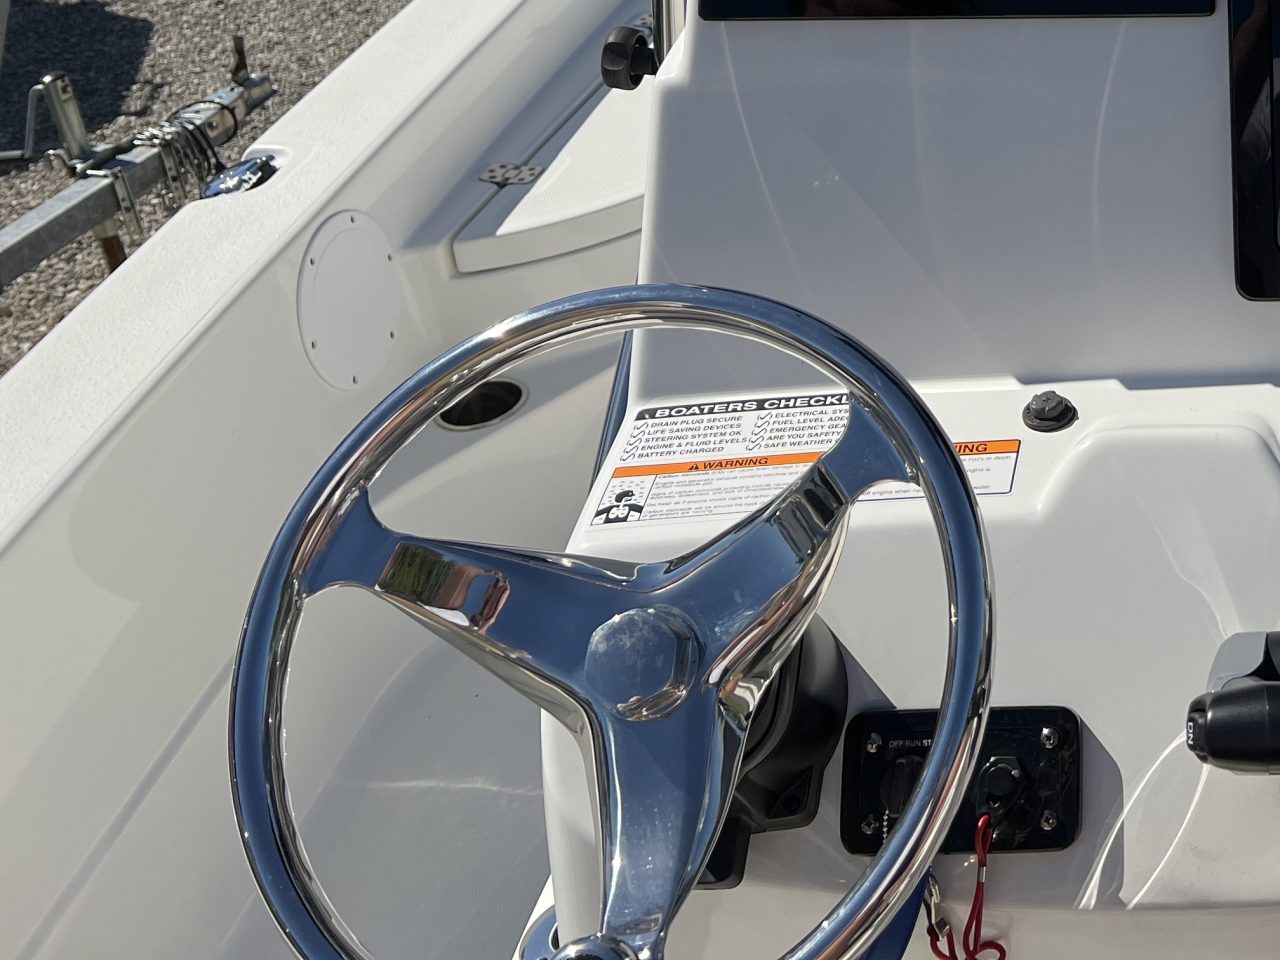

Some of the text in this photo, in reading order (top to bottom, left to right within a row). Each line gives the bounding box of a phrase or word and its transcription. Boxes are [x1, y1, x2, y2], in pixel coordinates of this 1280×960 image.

[655, 400, 760, 418] BOATERS
[774, 410, 828, 419] ELECTRICAL
[650, 415, 743, 428] DRAIN PLUG SECURE
[771, 418, 795, 426] FUEL
[797, 416, 825, 424] LEVEL
[647, 423, 741, 436] LIFE SAVING DEVICES
[769, 425, 826, 434] EMERGENCY
[807, 430, 841, 438] SAFETY
[644, 435, 685, 443] STEERING
[687, 431, 727, 440] SYSTEM
[640, 443, 674, 451] ENGINE
[685, 439, 714, 447] FLUID
[715, 437, 748, 445] LEVELS
[763, 438, 832, 449] SAFE WEATHER
[637, 446, 724, 459] BATTERY CHARGED
[703, 457, 768, 470] WARNING
[1187, 722, 1194, 745] DN
[889, 740, 903, 748] OFF
[905, 739, 920, 747] RUN
